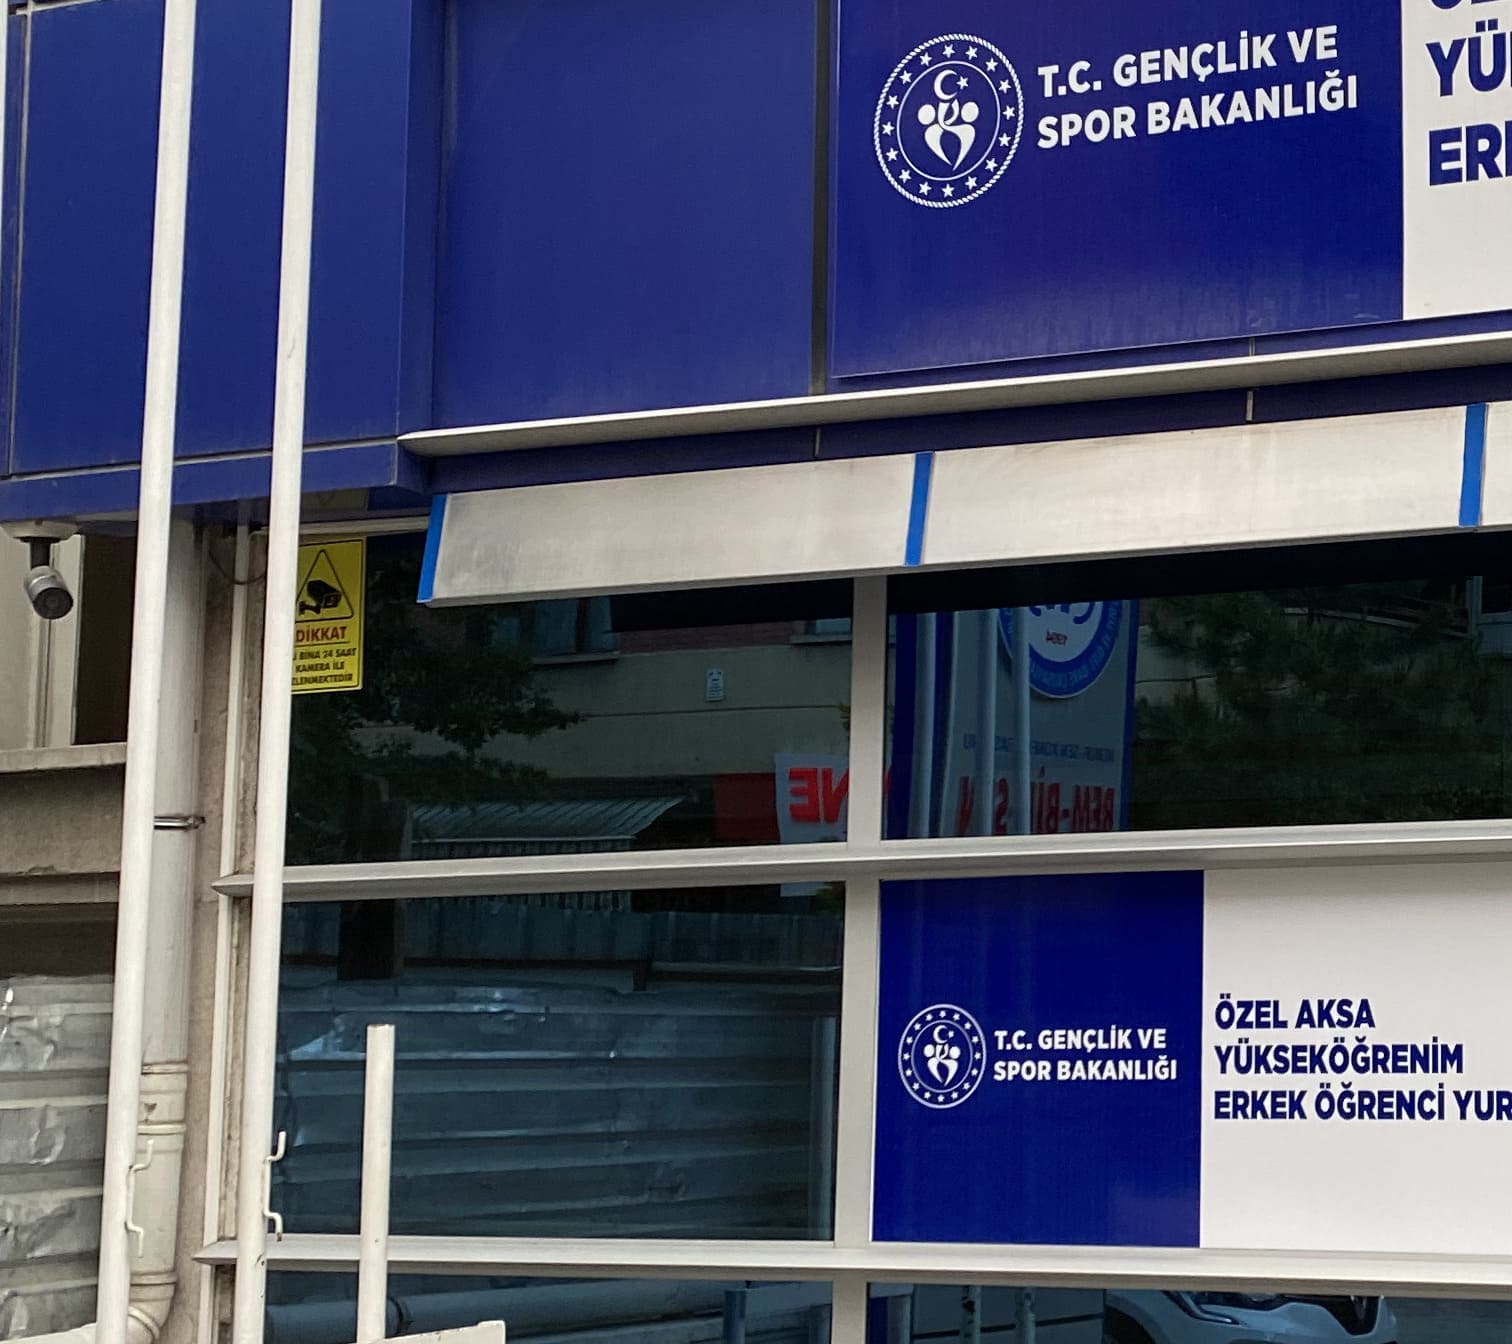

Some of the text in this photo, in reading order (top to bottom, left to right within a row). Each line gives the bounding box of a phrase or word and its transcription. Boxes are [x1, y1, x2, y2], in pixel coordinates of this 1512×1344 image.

[1037, 24, 1338, 98] T.C. GENÇLİK VE
[1037, 69, 1358, 149] SPOR BAKANLIĞI
[296, 625, 347, 642] DİKKAT
[295, 662, 330, 673] KAMERA
[1214, 992, 1376, 1030] ÖZEL AKSA
[994, 1024, 1167, 1053] T.C. GENÇLİK VE
[1214, 1035, 1464, 1075] YÜKSEKÖĞRENİM
[993, 1055, 1178, 1081] SPOR BAKANLIĞI
[1214, 1090, 1308, 1120] ERKEK
[1314, 1081, 1446, 1121] ÖĞRENCİ
